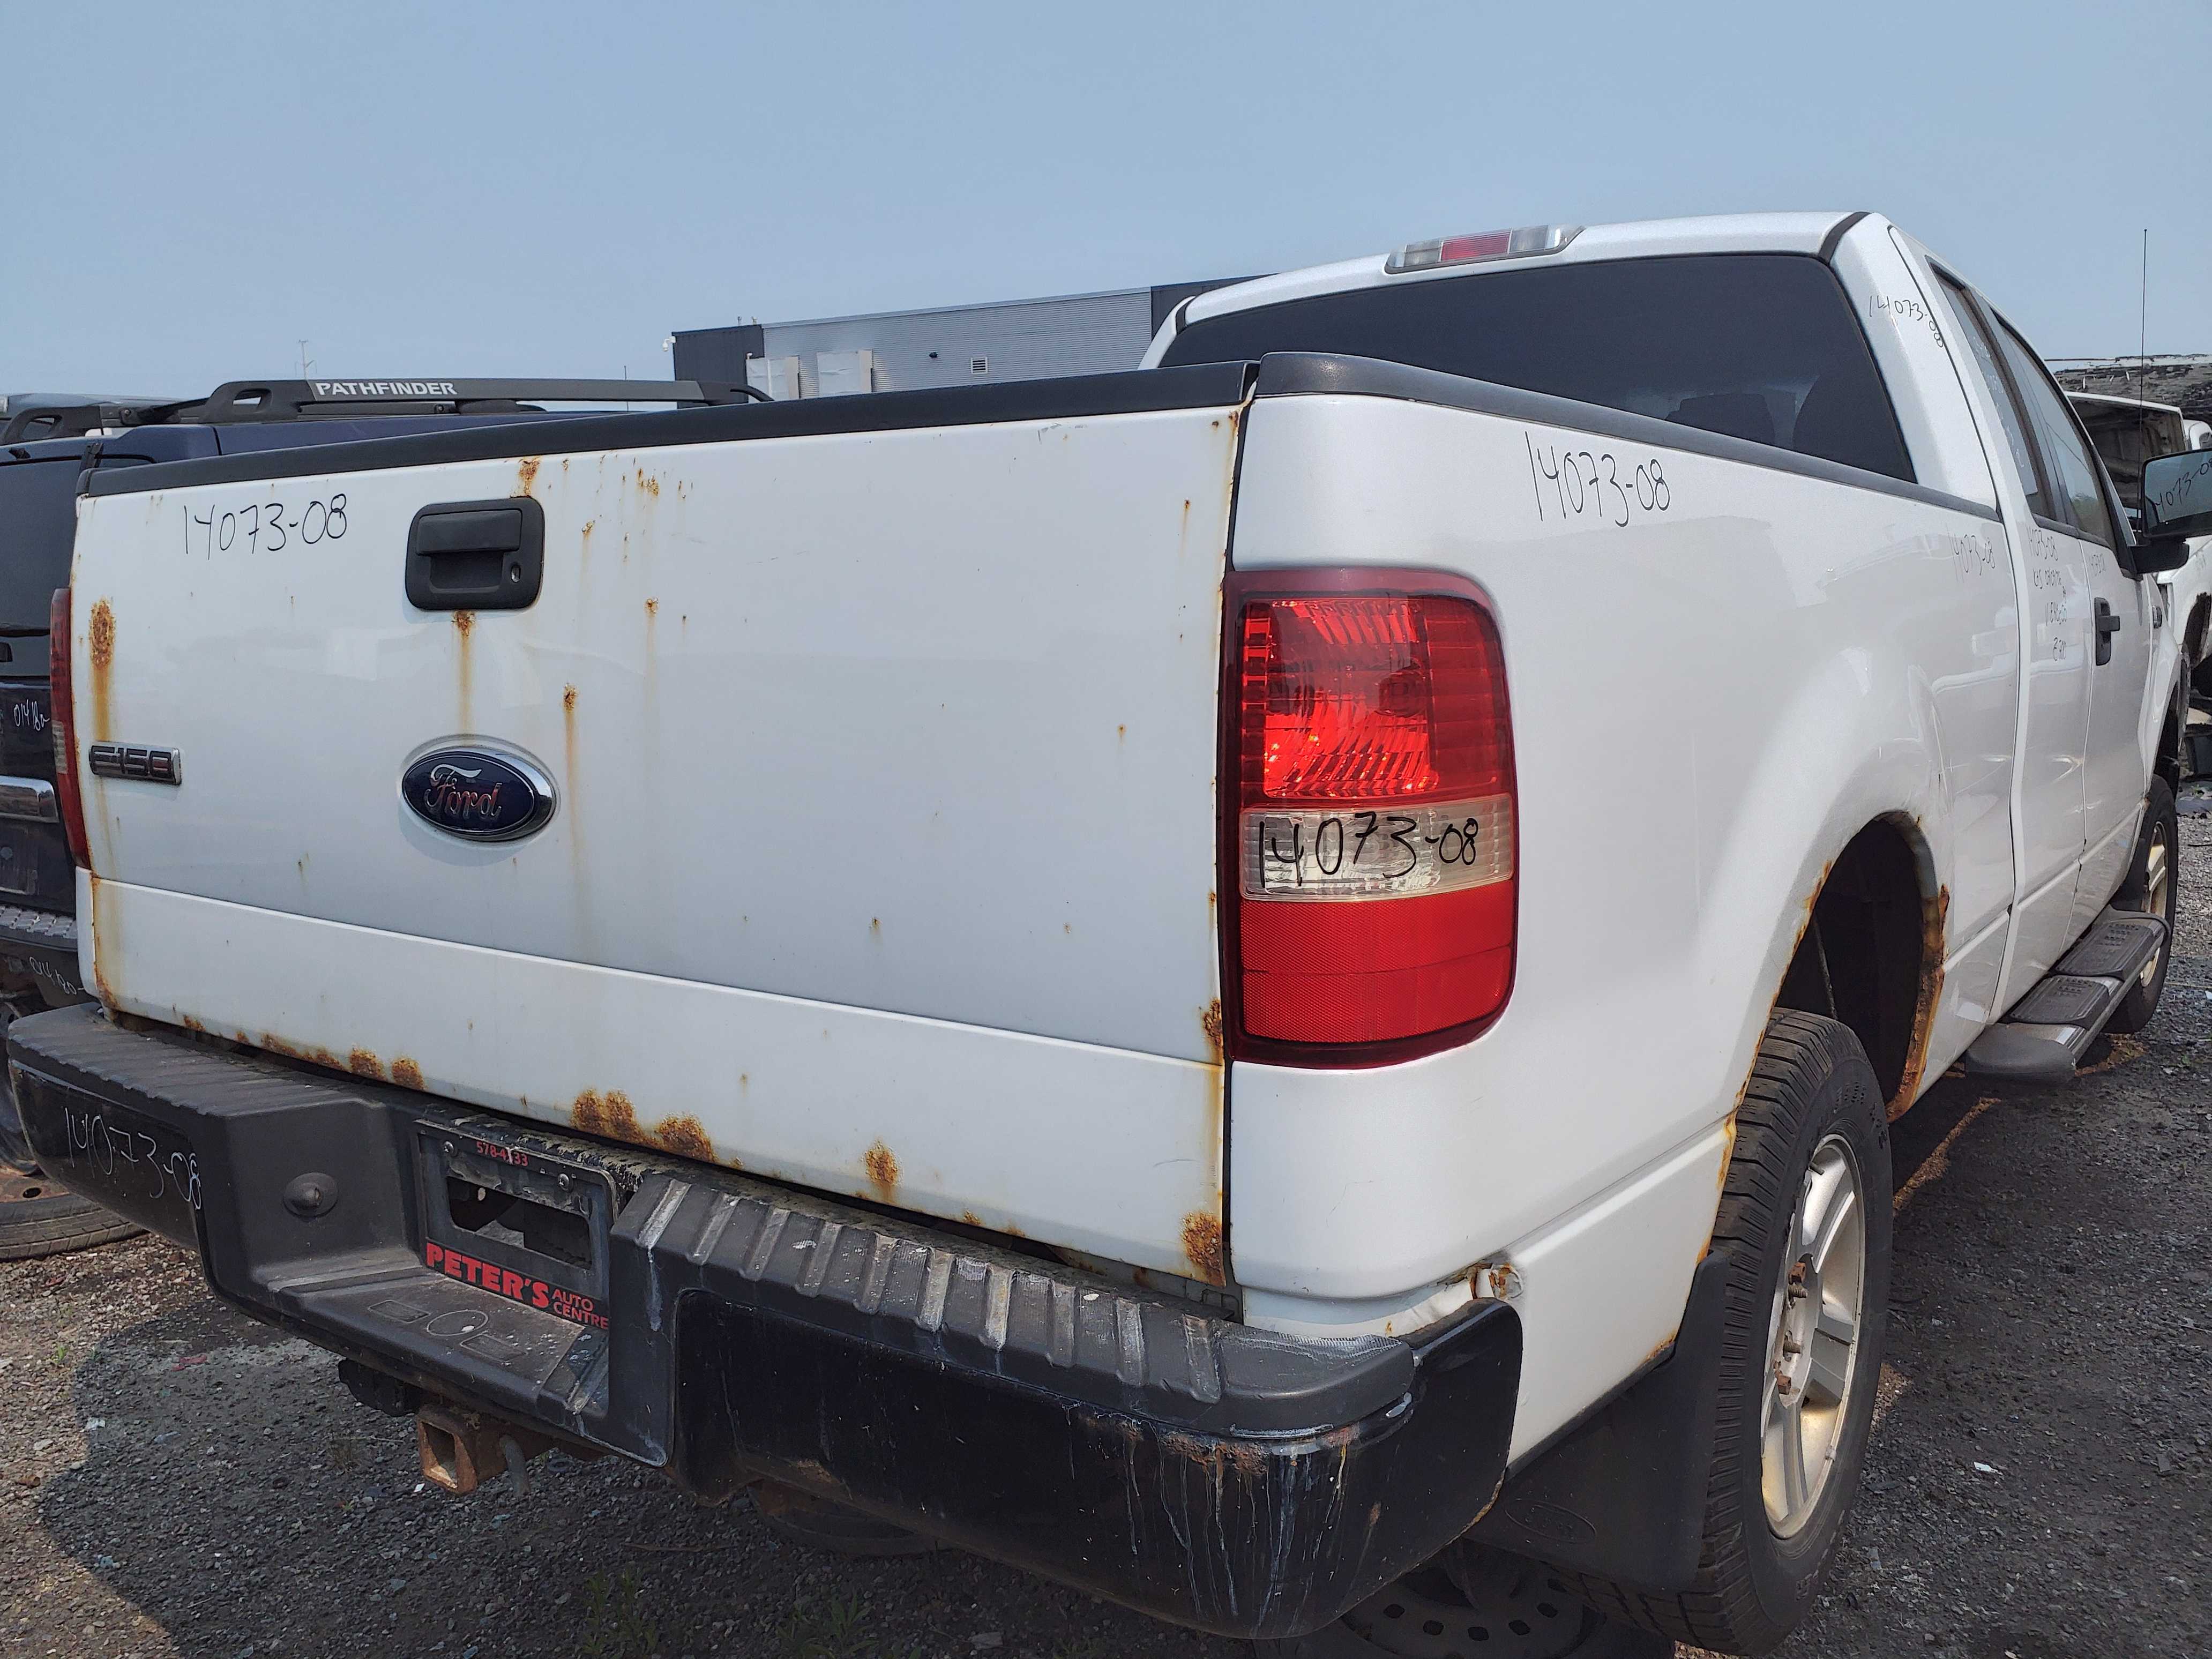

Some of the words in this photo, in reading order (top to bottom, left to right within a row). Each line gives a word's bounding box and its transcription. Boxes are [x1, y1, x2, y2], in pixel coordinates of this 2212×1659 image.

[316, 382, 457, 395] PATHFINDER
[1525, 431, 1670, 527] 14073-08
[184, 493, 347, 561] 14073-08
[424, 764, 502, 819] Ford
[1260, 811, 1479, 888] 14073-08
[65, 1107, 201, 1210] 14073-08
[426, 1242, 549, 1309] PETER'S
[552, 1289, 594, 1312] AUTO
[553, 1301, 609, 1330] CENTRE
